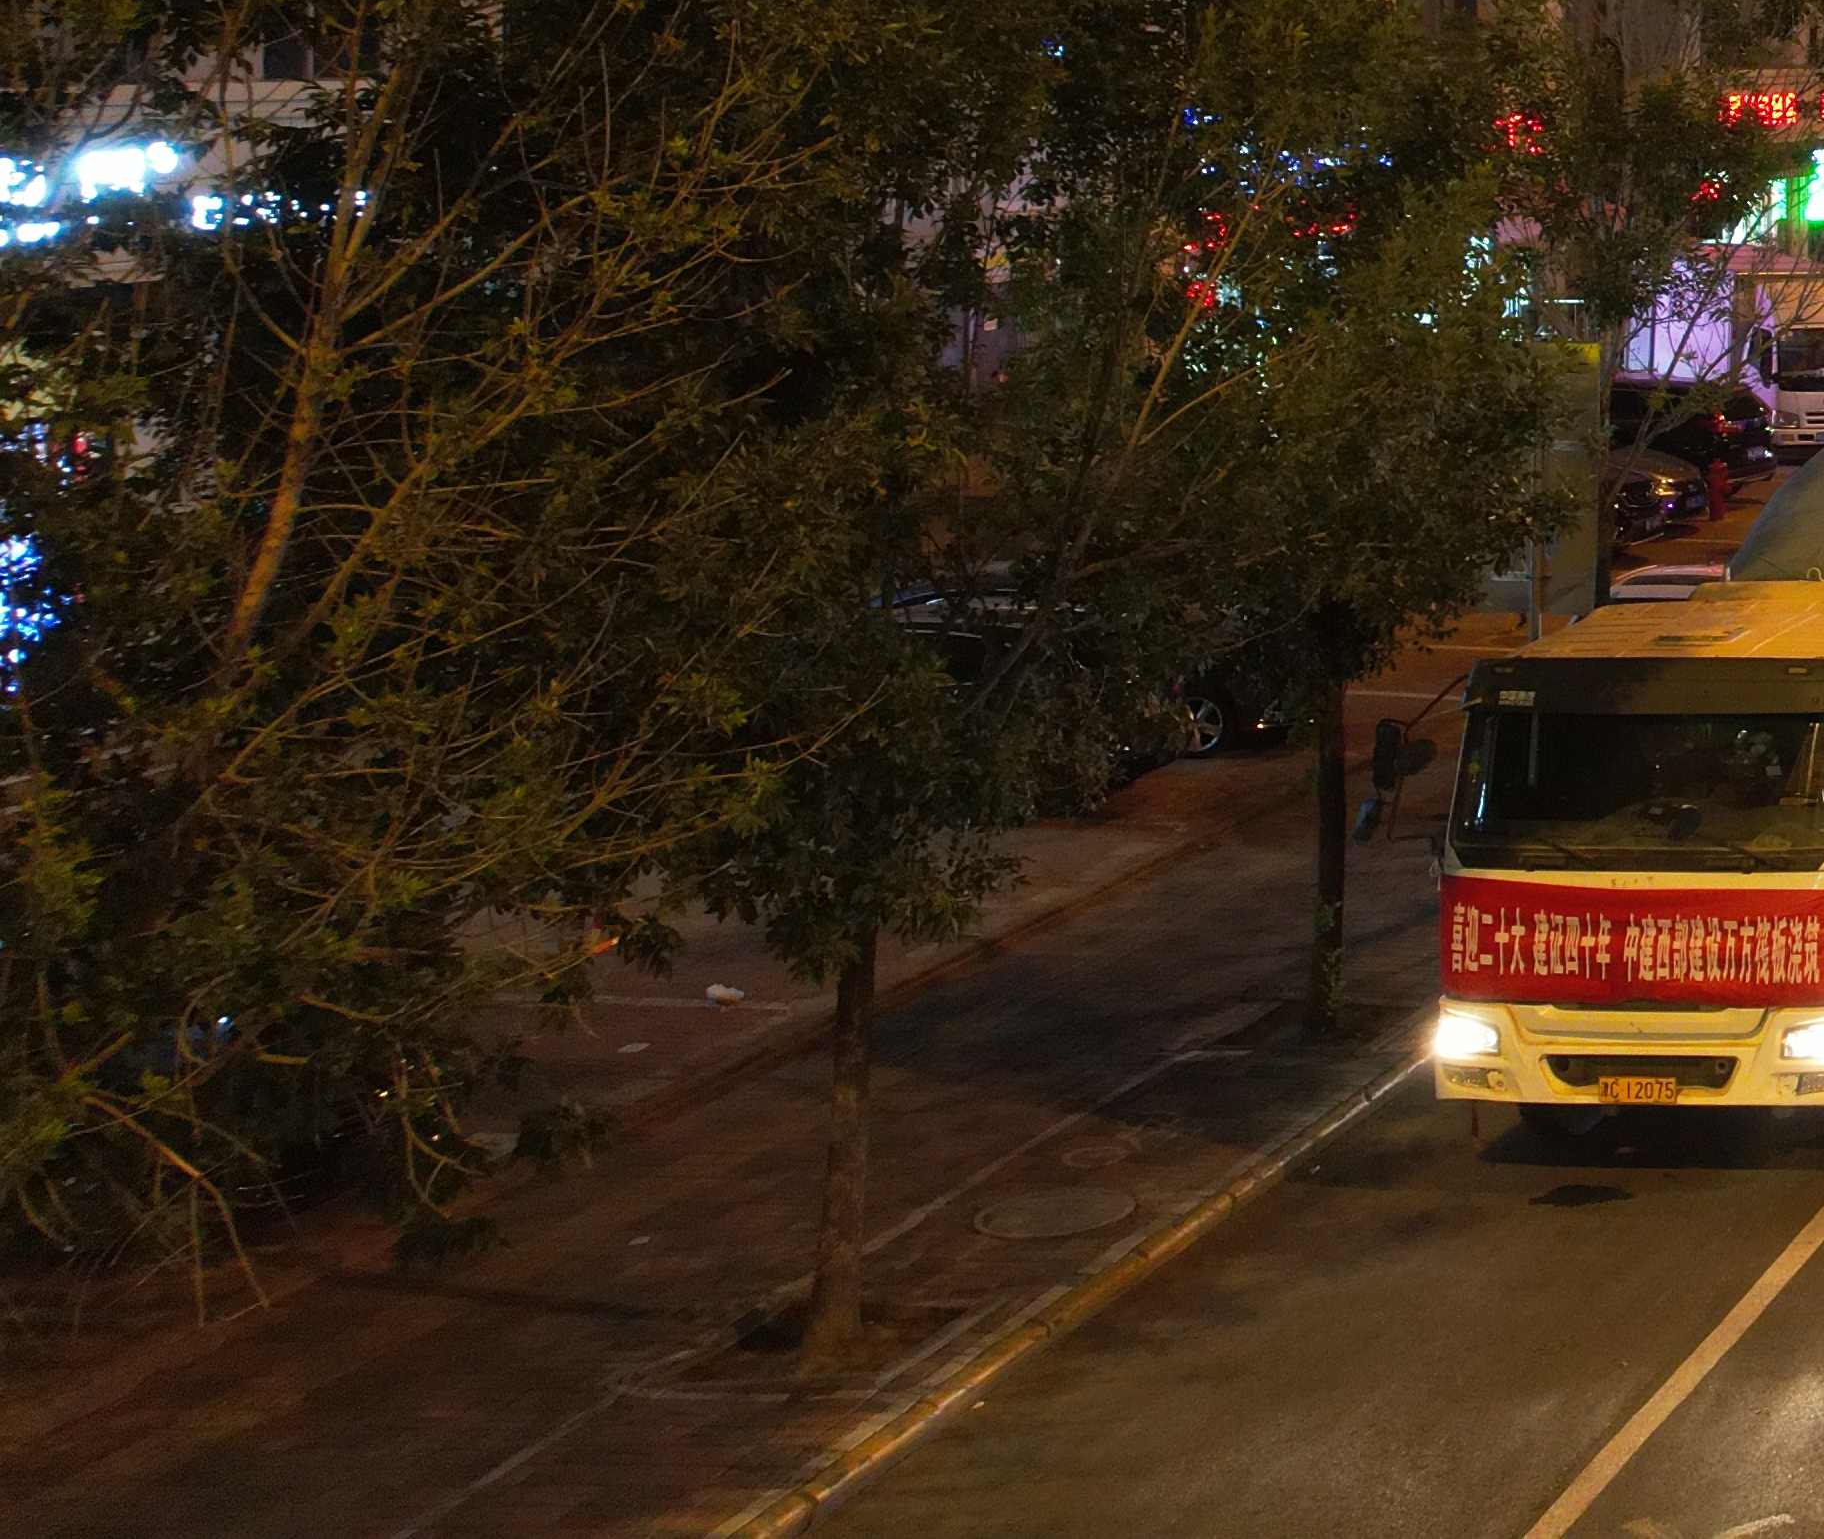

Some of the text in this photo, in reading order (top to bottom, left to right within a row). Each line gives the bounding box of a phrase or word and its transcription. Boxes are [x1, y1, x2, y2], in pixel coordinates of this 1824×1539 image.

[1451, 901, 1526, 976] 喜迎二十大
[1533, 908, 1612, 980] 建证四十年
